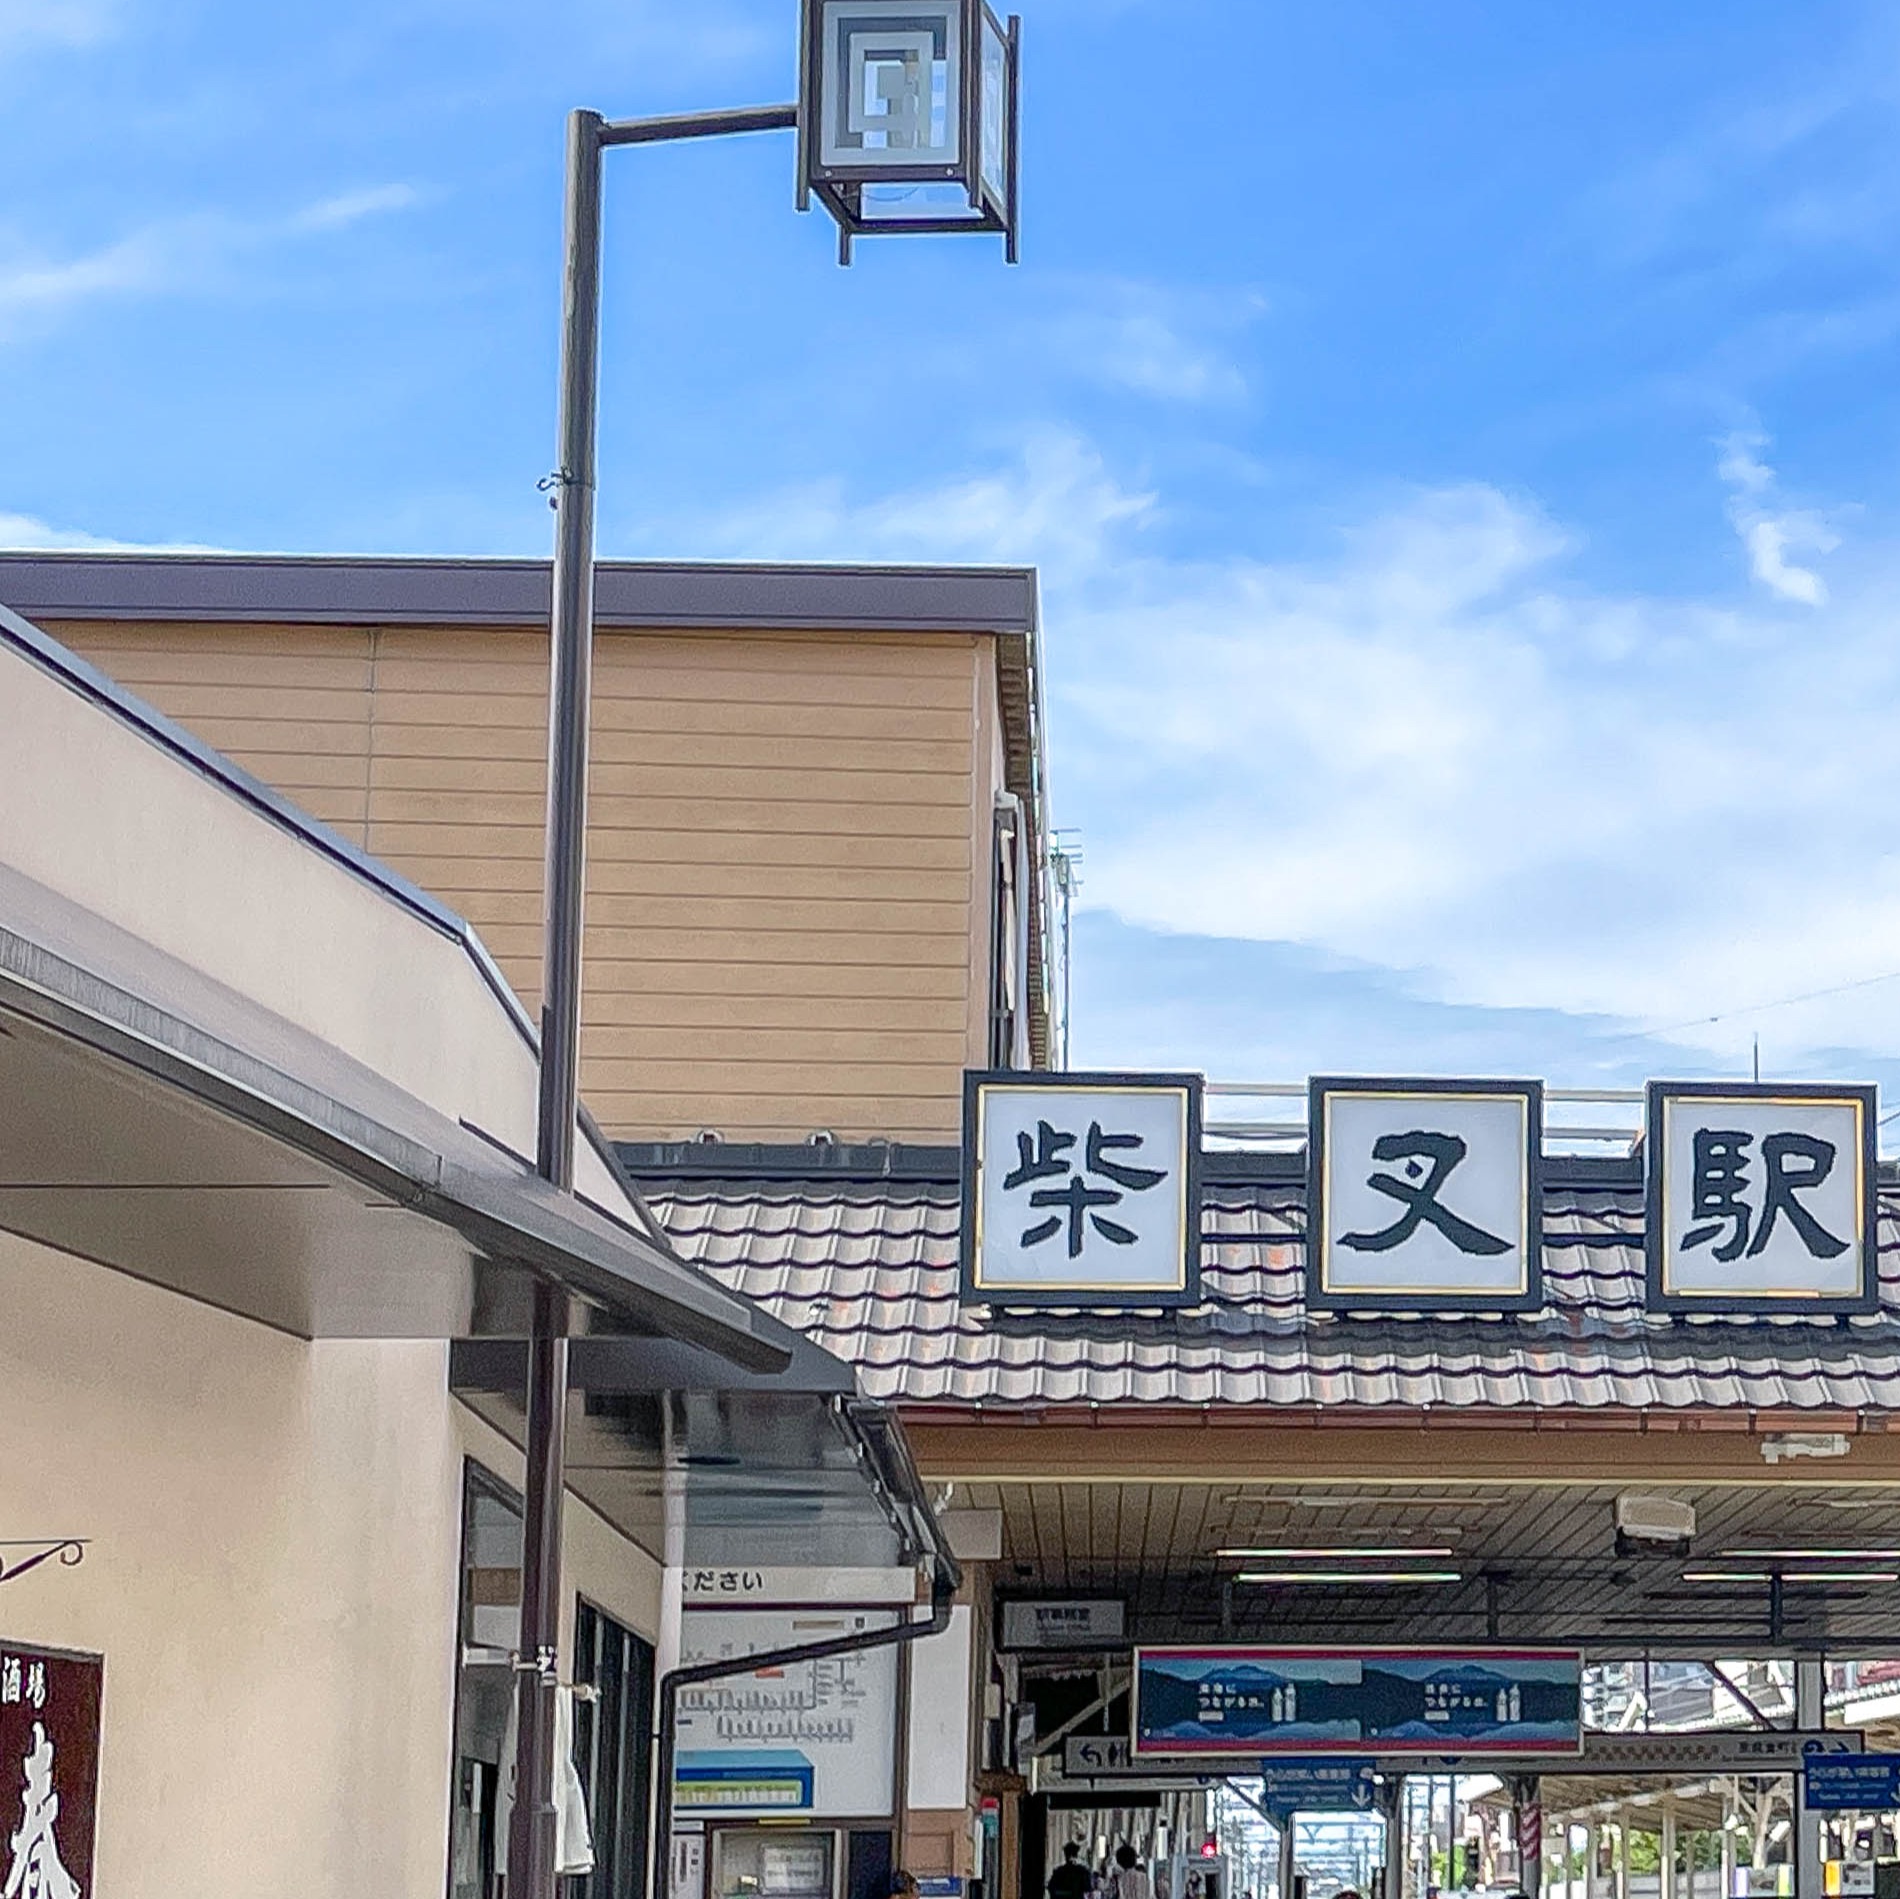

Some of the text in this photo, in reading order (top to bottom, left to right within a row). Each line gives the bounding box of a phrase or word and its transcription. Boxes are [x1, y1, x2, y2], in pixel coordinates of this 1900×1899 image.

[1002, 1117, 1851, 1262] 柴又駅
[3, 1656, 46, 1709] 酒場
